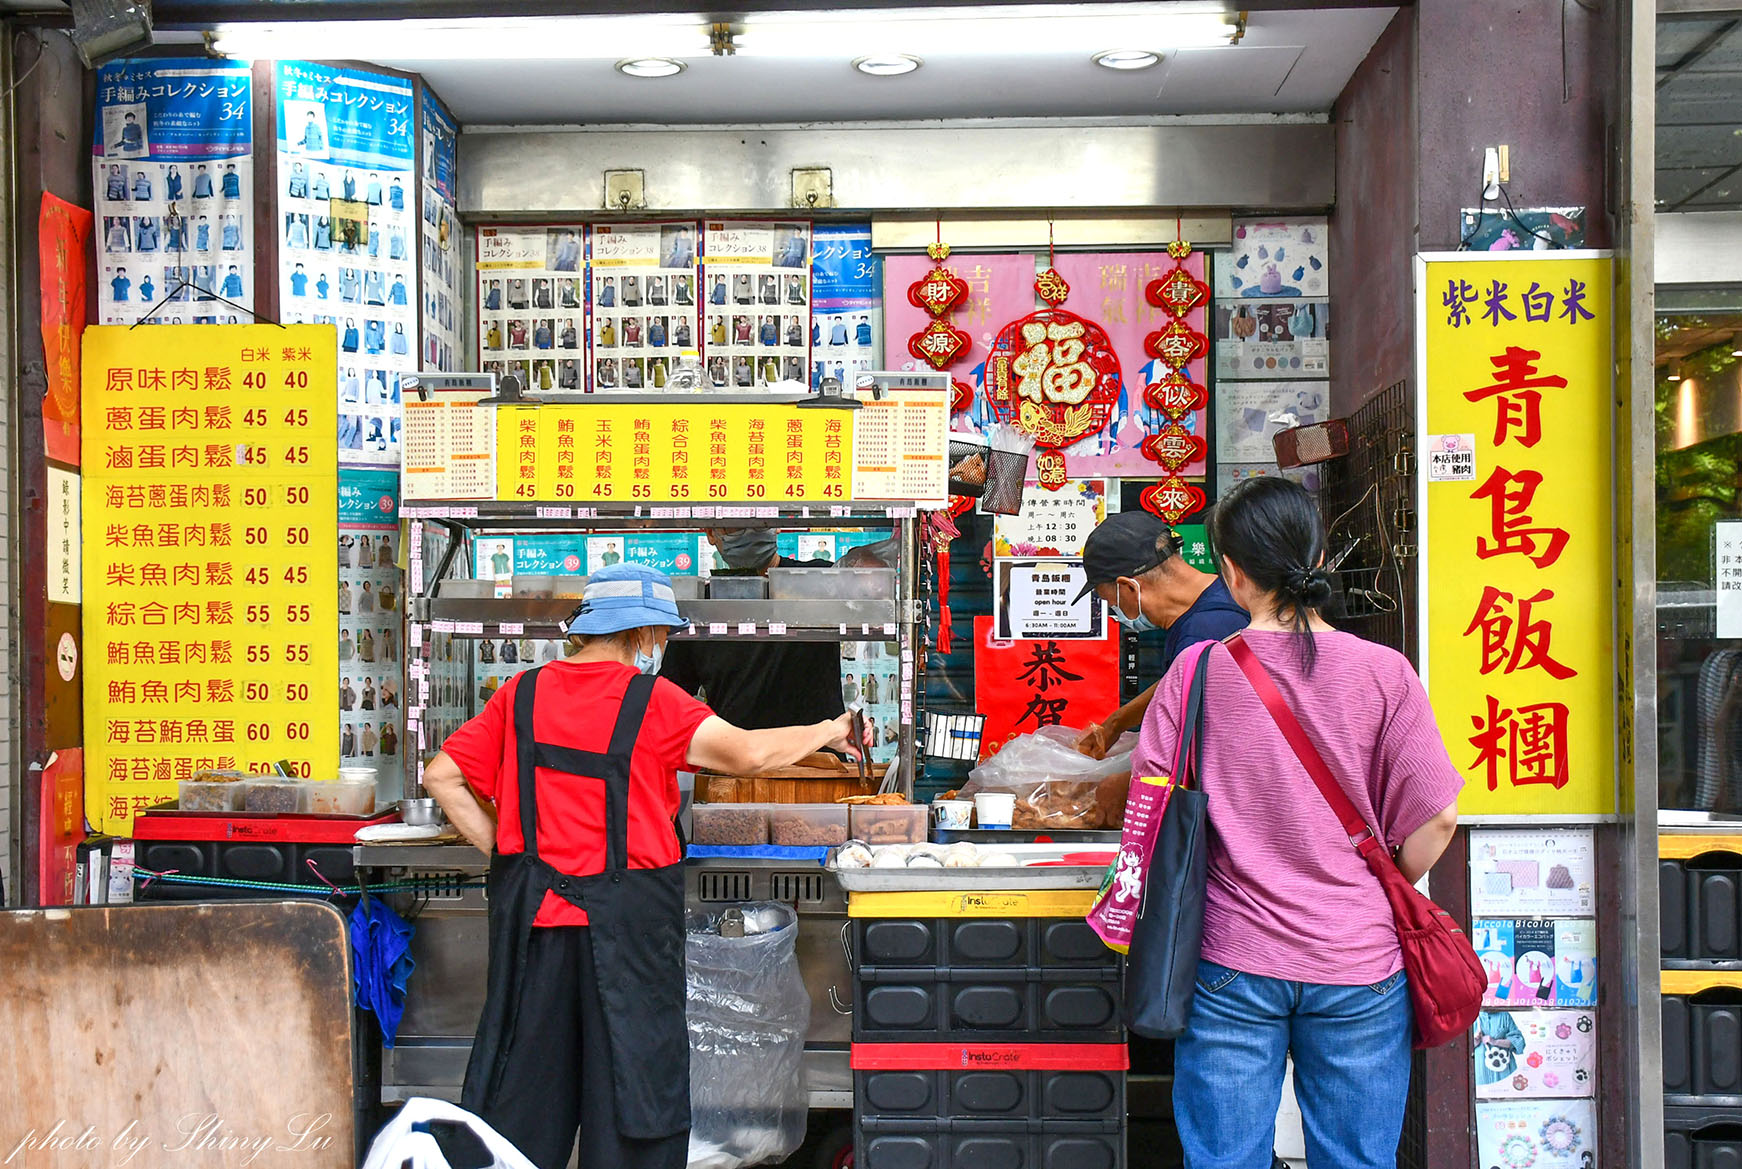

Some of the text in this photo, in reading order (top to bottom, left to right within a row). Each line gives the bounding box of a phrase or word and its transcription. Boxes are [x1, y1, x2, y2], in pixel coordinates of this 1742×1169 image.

[101, 82, 246, 103] 手編みコレクション
[281, 80, 409, 115] 手編みコレクション
[219, 100, 246, 121] 34
[387, 119, 409, 137] 34
[1442, 278, 1596, 329] 紫米白米
[241, 346, 312, 362] 白米 紫米
[1011, 320, 1098, 405] 福
[106, 367, 308, 391] 原味肉鬆 40 40
[244, 409, 267, 426] 45
[285, 409, 308, 426] 45
[106, 445, 308, 468] 滷蛋肉鬆 45 45
[516, 419, 536, 497] 柴魚肉鬆 45
[556, 419, 574, 497] 鮪魚肉鬆 50
[593, 419, 612, 497] 玉米肉鬆 45
[632, 419, 651, 497] 鮪魚蛋肉鬆 55
[670, 419, 689, 497] 綜合肉鬆 55
[709, 419, 727, 497] 柴魚蛋肉鬆 50
[746, 419, 765, 497] 海苔蛋肉鬆 50
[823, 419, 843, 497] 海苔肉鬆 45
[1432, 453, 1471, 464] 本店使用
[1452, 464, 1471, 474] 豬肉
[244, 488, 267, 506] 50
[286, 487, 309, 504] 50
[338, 486, 362, 497] 編み
[786, 484, 805, 497] 45
[382, 499, 393, 510] 39
[1022, 499, 1086, 507] 傳營業時間
[106, 523, 309, 547] 柴魚蛋肉鬆 50 50
[516, 558, 579, 569] コレクション 39
[517, 549, 547, 558] 手編み
[629, 547, 658, 557] 手編み
[677, 558, 690, 568] 39
[106, 562, 307, 586] 柴魚肉鬆 45 45
[1462, 345, 1579, 792] 青島飯糰
[107, 601, 310, 626] 綜合肉鬆 55 55
[107, 640, 309, 665] 鮪魚蛋肉鬆 55 55
[108, 679, 308, 704] 鮪魚肉鬆 50 50
[1015, 641, 1084, 729] 恭賀
[107, 720, 309, 744] 海苔鮪魚蛋 60 60
[1515, 920, 1554, 928] Bicolor
